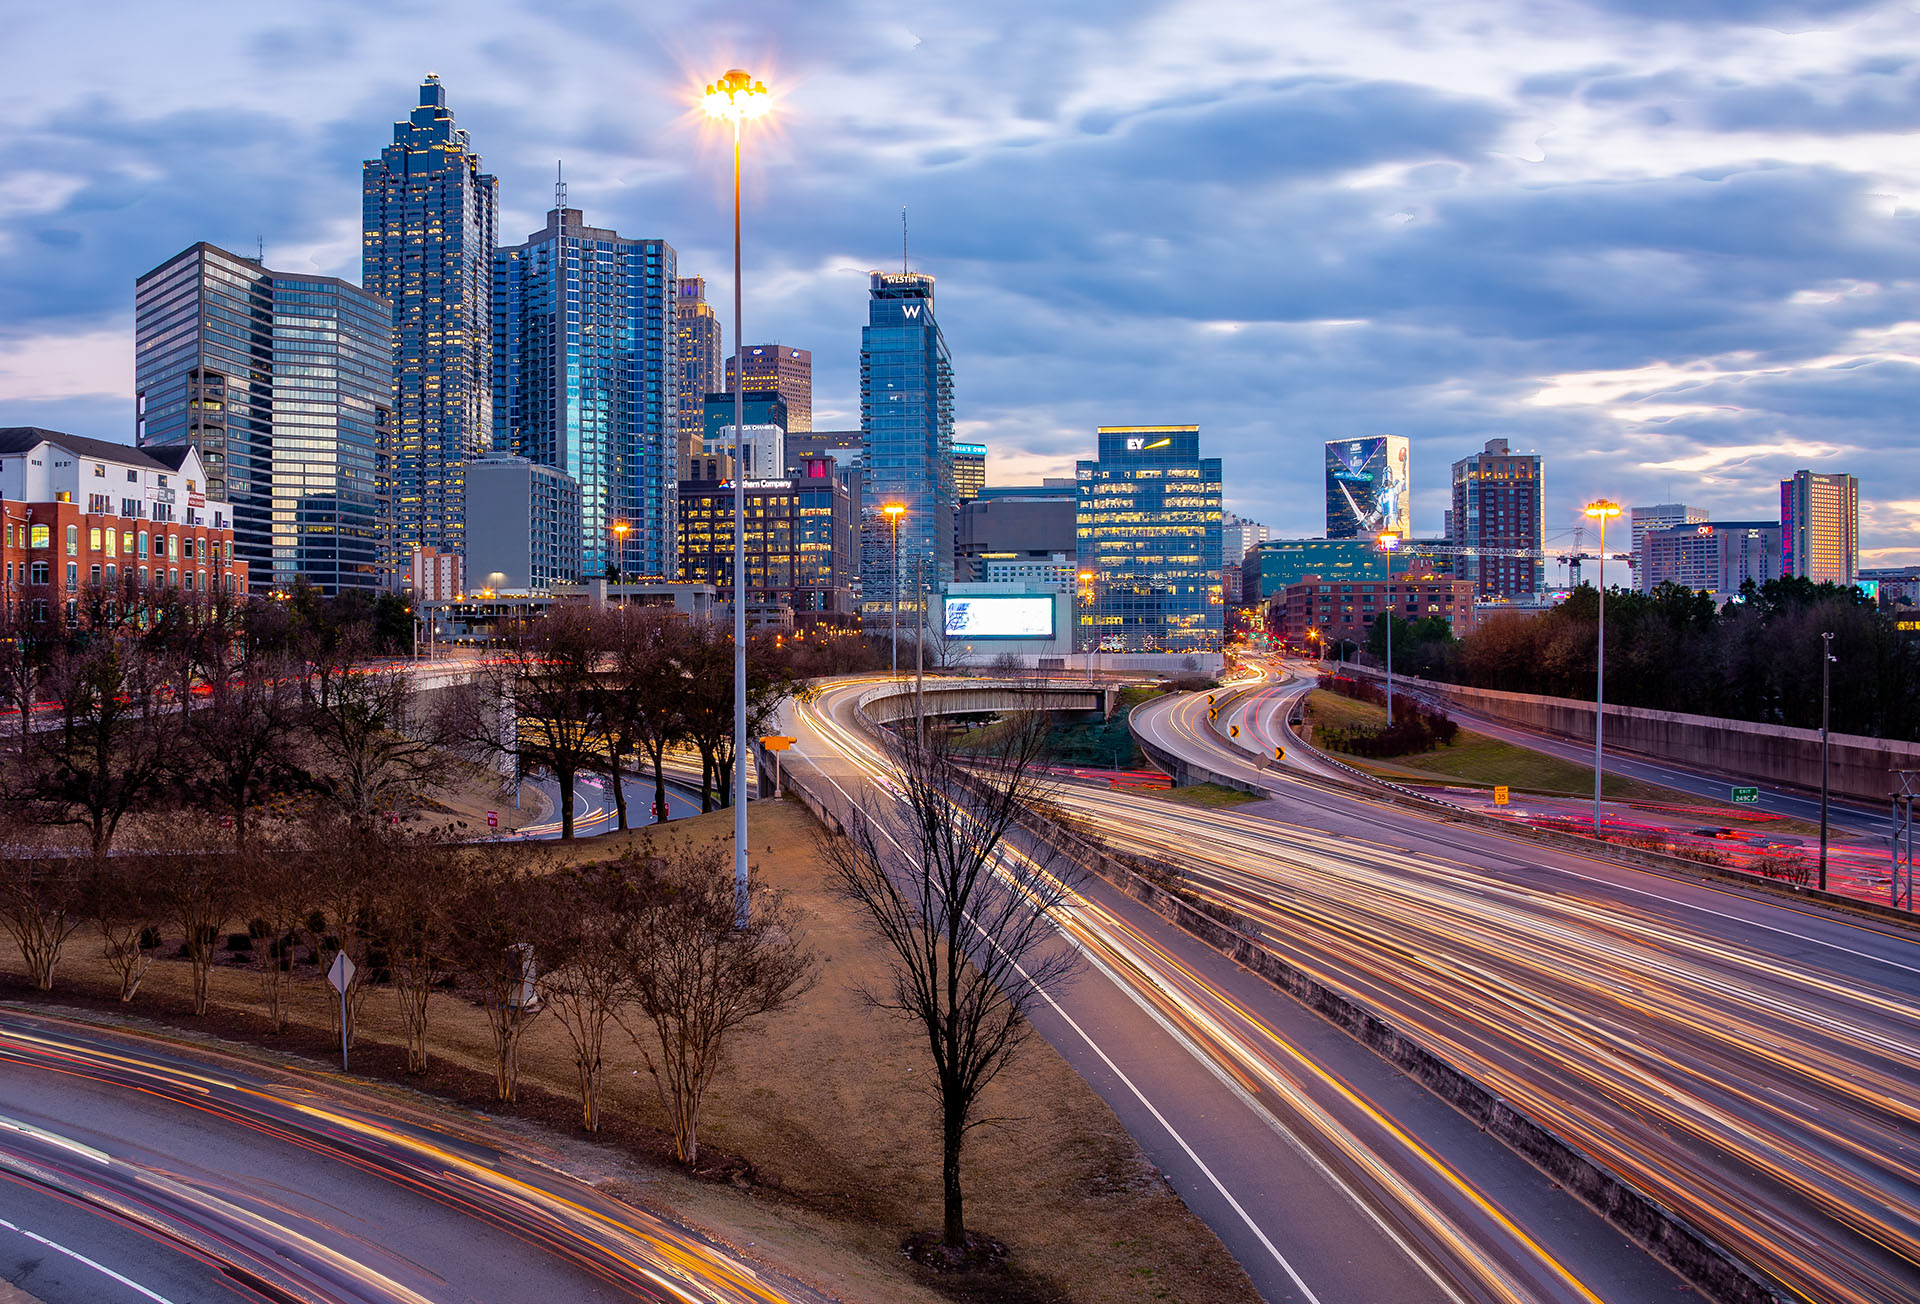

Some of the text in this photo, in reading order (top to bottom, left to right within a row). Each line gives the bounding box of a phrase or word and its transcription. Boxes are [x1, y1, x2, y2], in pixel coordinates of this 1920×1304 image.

[887, 276, 918, 284] WESTIN
[902, 305, 921, 319] W
[1127, 438, 1145, 450] EY
[729, 480, 792, 489] Sthern Company
[1783, 484, 1792, 521] SUPER
[1783, 524, 1792, 556] BOWL
